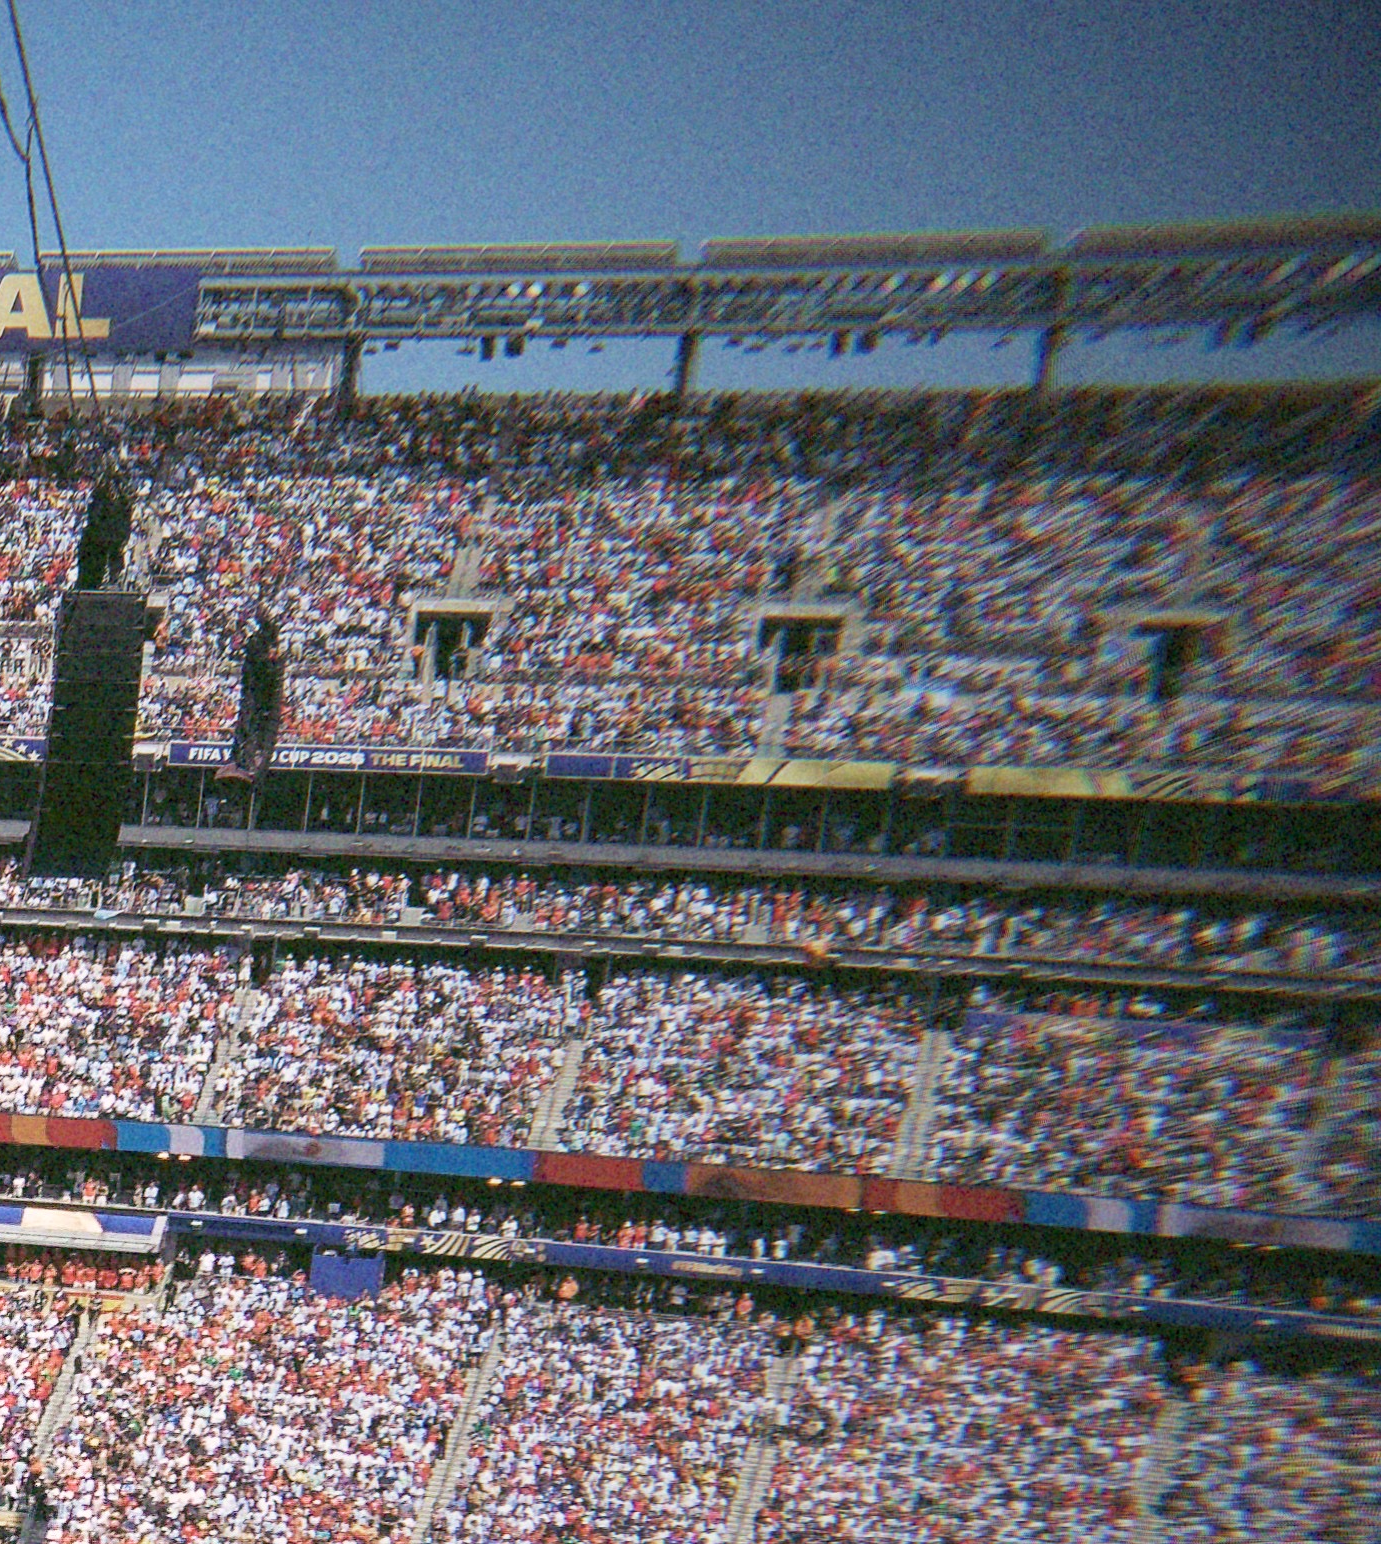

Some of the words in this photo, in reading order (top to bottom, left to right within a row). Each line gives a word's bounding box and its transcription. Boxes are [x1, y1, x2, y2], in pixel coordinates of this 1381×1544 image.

[188, 746, 222, 762] FIFA
[281, 750, 311, 766] CUP
[312, 751, 365, 766] 2026
[369, 753, 408, 768] THE
[409, 754, 465, 769] FINAL
